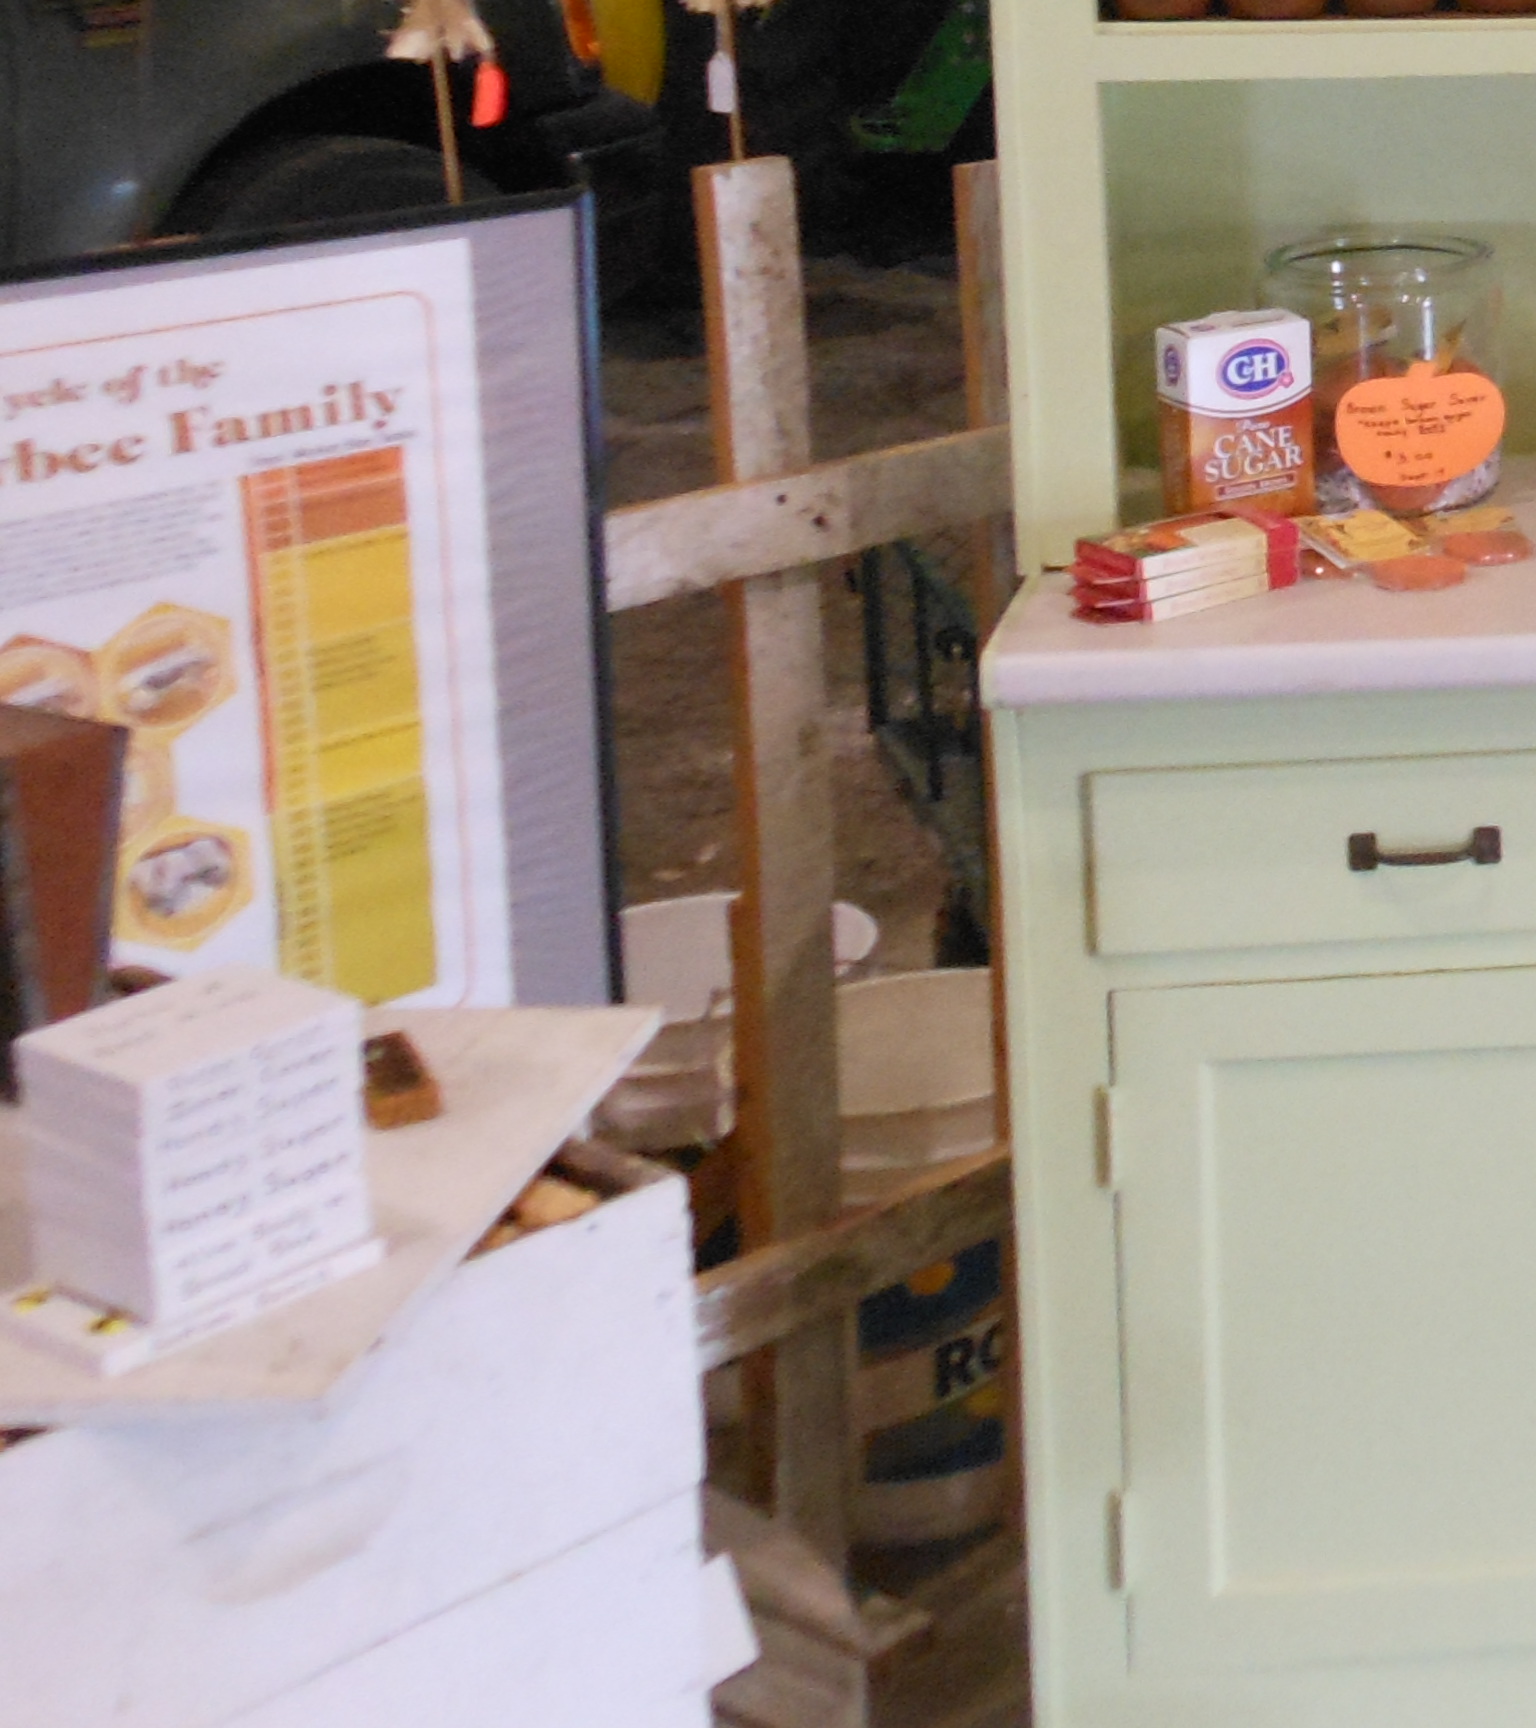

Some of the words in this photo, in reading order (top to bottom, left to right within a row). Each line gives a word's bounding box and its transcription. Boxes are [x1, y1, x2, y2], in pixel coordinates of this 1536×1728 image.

[102, 364, 149, 404] of
[169, 380, 405, 455] Family
[1214, 425, 1294, 459] CANE
[1204, 445, 1304, 482] SUGAR
